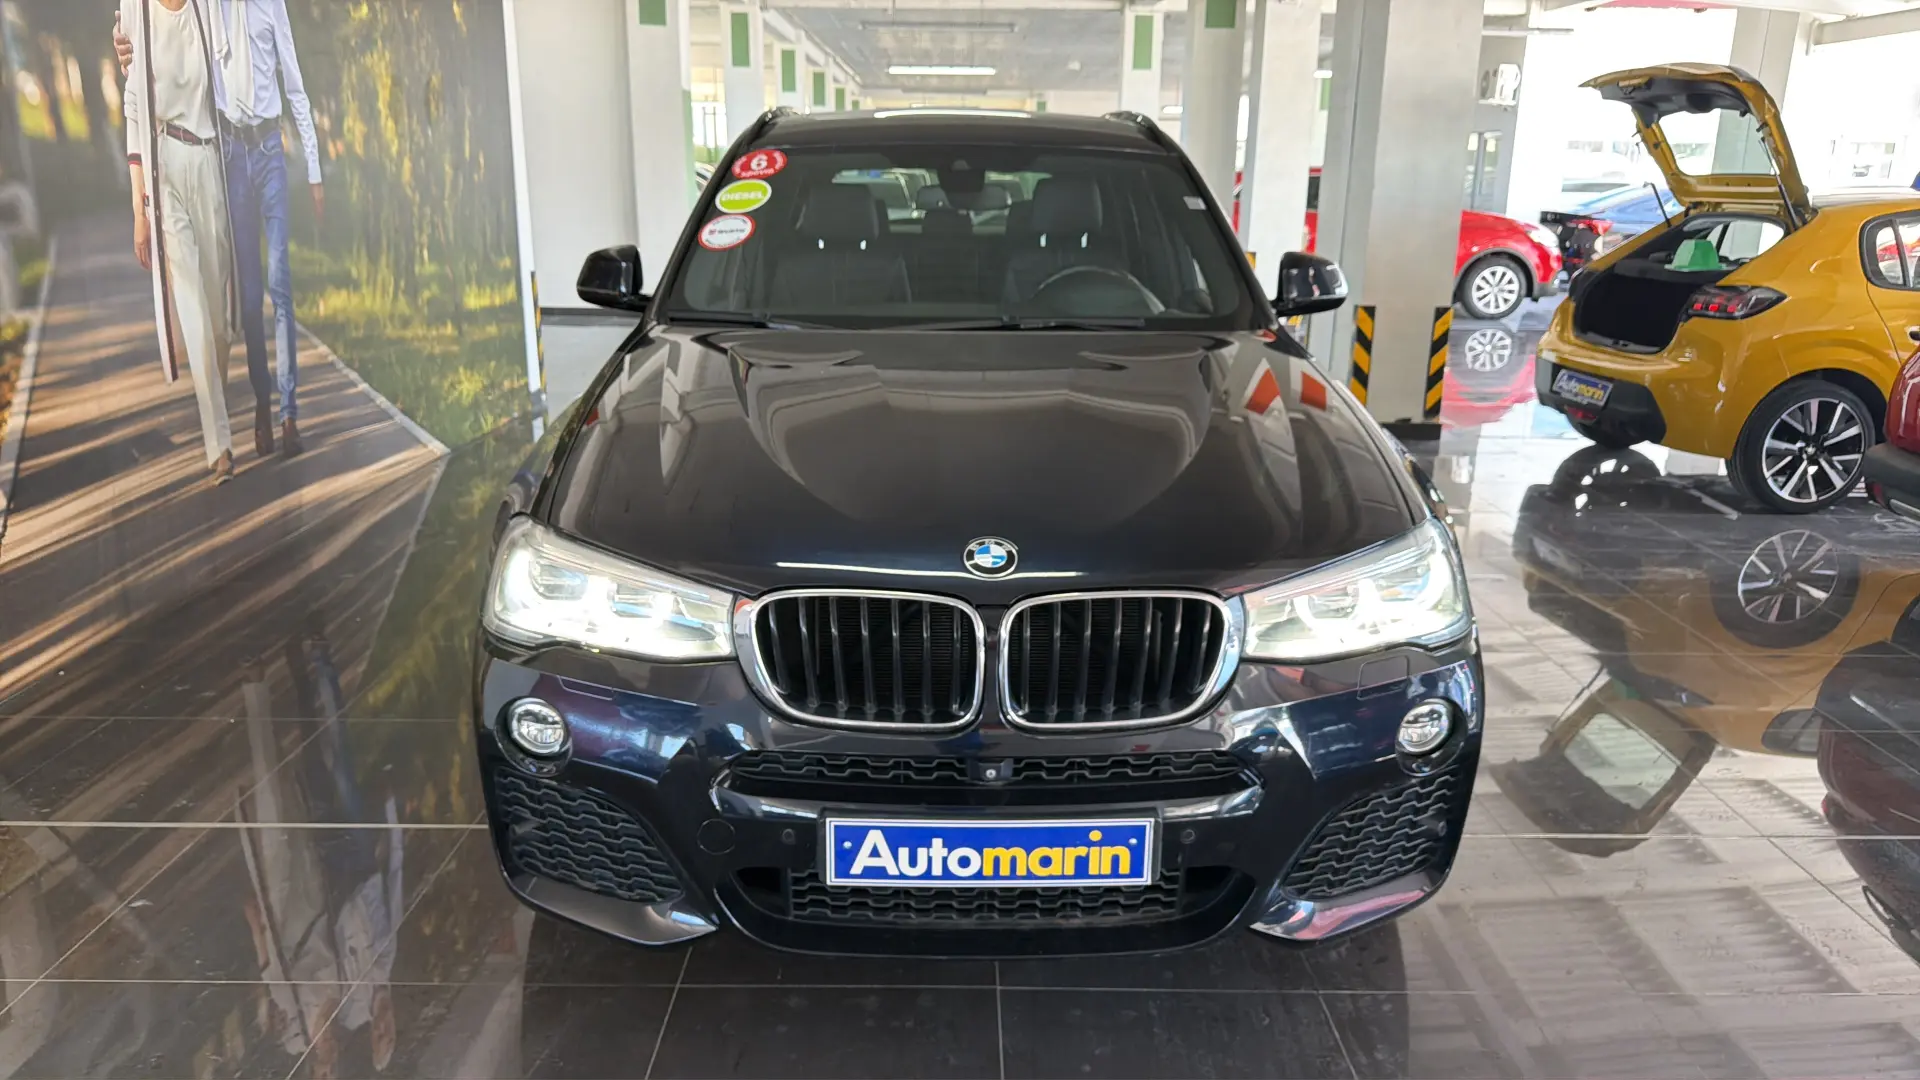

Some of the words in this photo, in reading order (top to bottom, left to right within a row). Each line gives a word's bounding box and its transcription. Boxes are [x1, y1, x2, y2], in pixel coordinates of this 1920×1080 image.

[750, 154, 768, 171] 6
[721, 190, 764, 202] DIESEL
[849, 829, 1131, 877] Automarin
